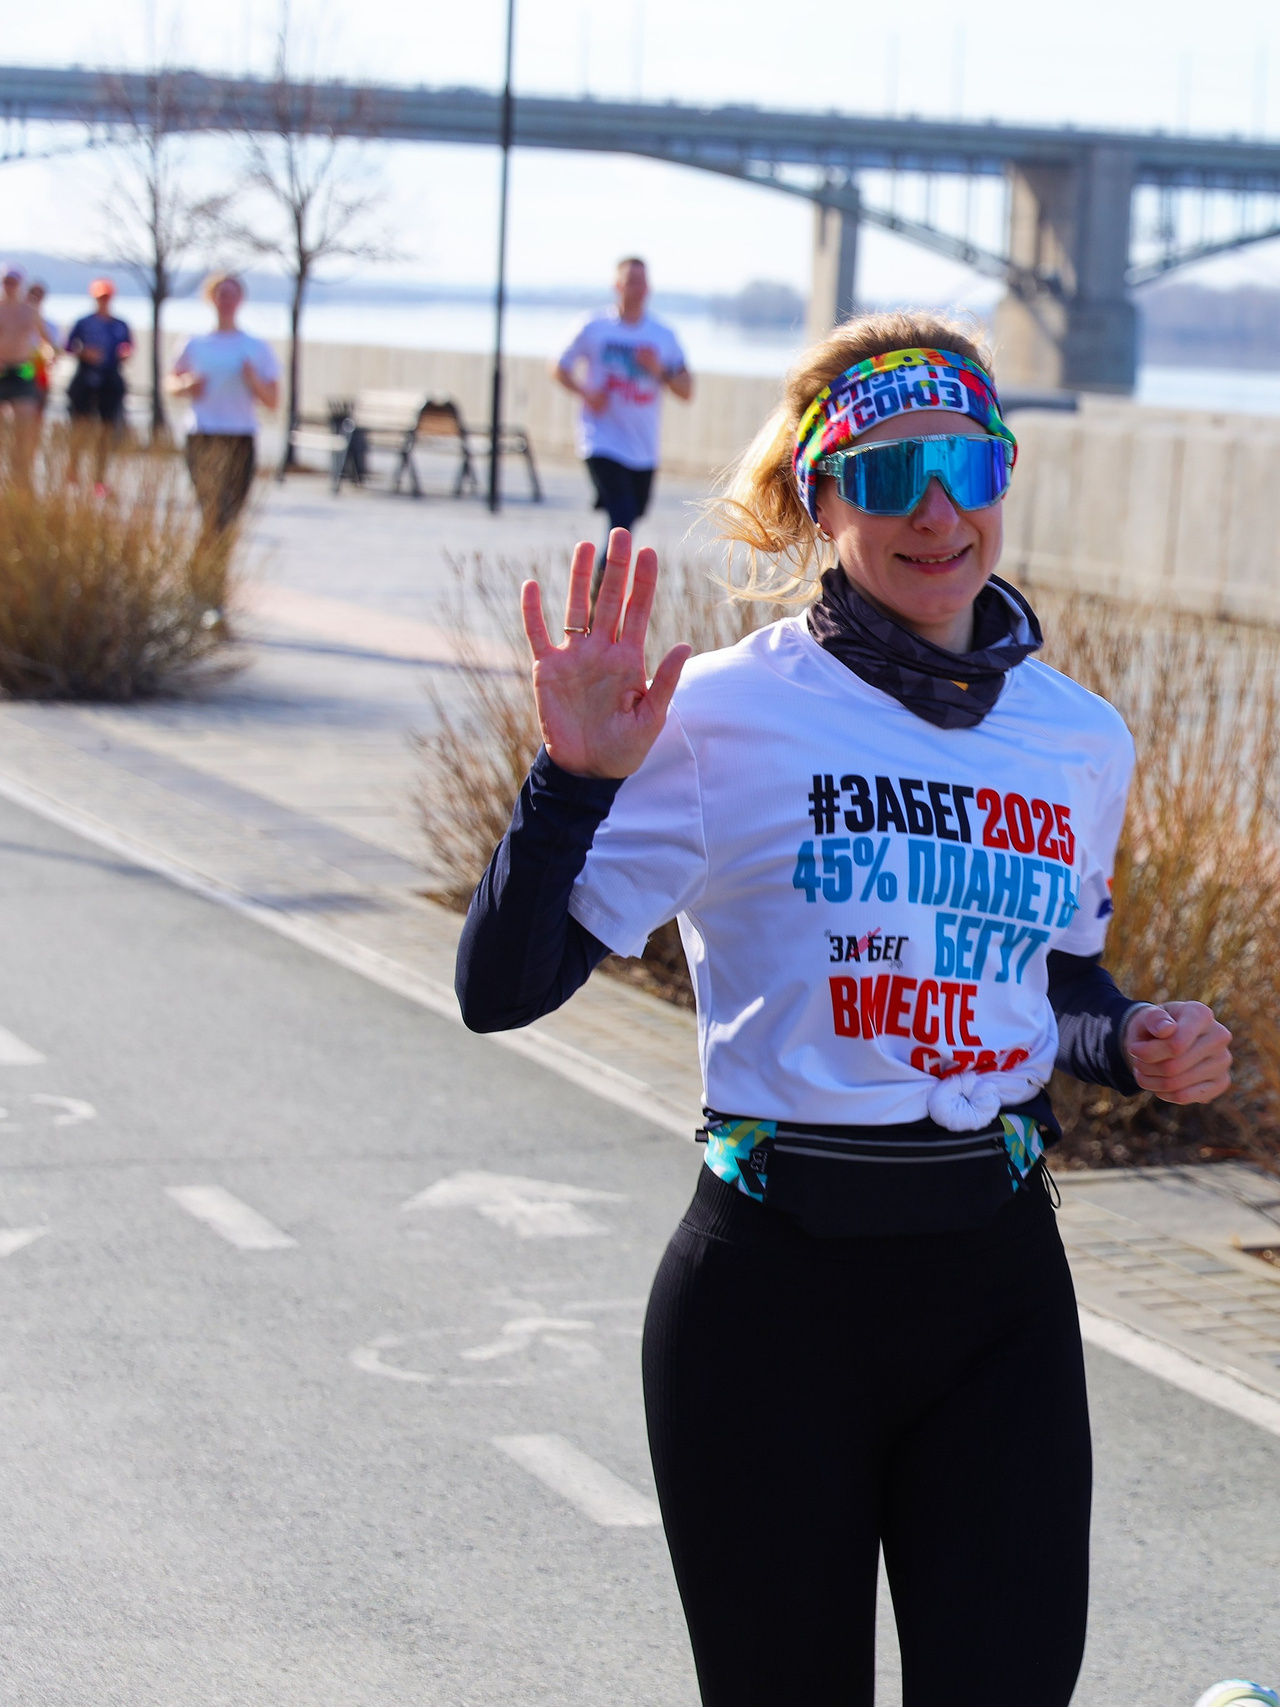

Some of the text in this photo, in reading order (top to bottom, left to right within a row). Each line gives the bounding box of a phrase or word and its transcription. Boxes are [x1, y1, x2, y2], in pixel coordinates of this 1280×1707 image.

[851, 379, 963, 430] СОЮЗ
[808, 774, 1076, 867] #ЗАБЕГ2025
[793, 836, 898, 904] 45%
[934, 911, 1051, 984] БЕГУТ
[828, 974, 983, 1047] ВМЕСТЕ
